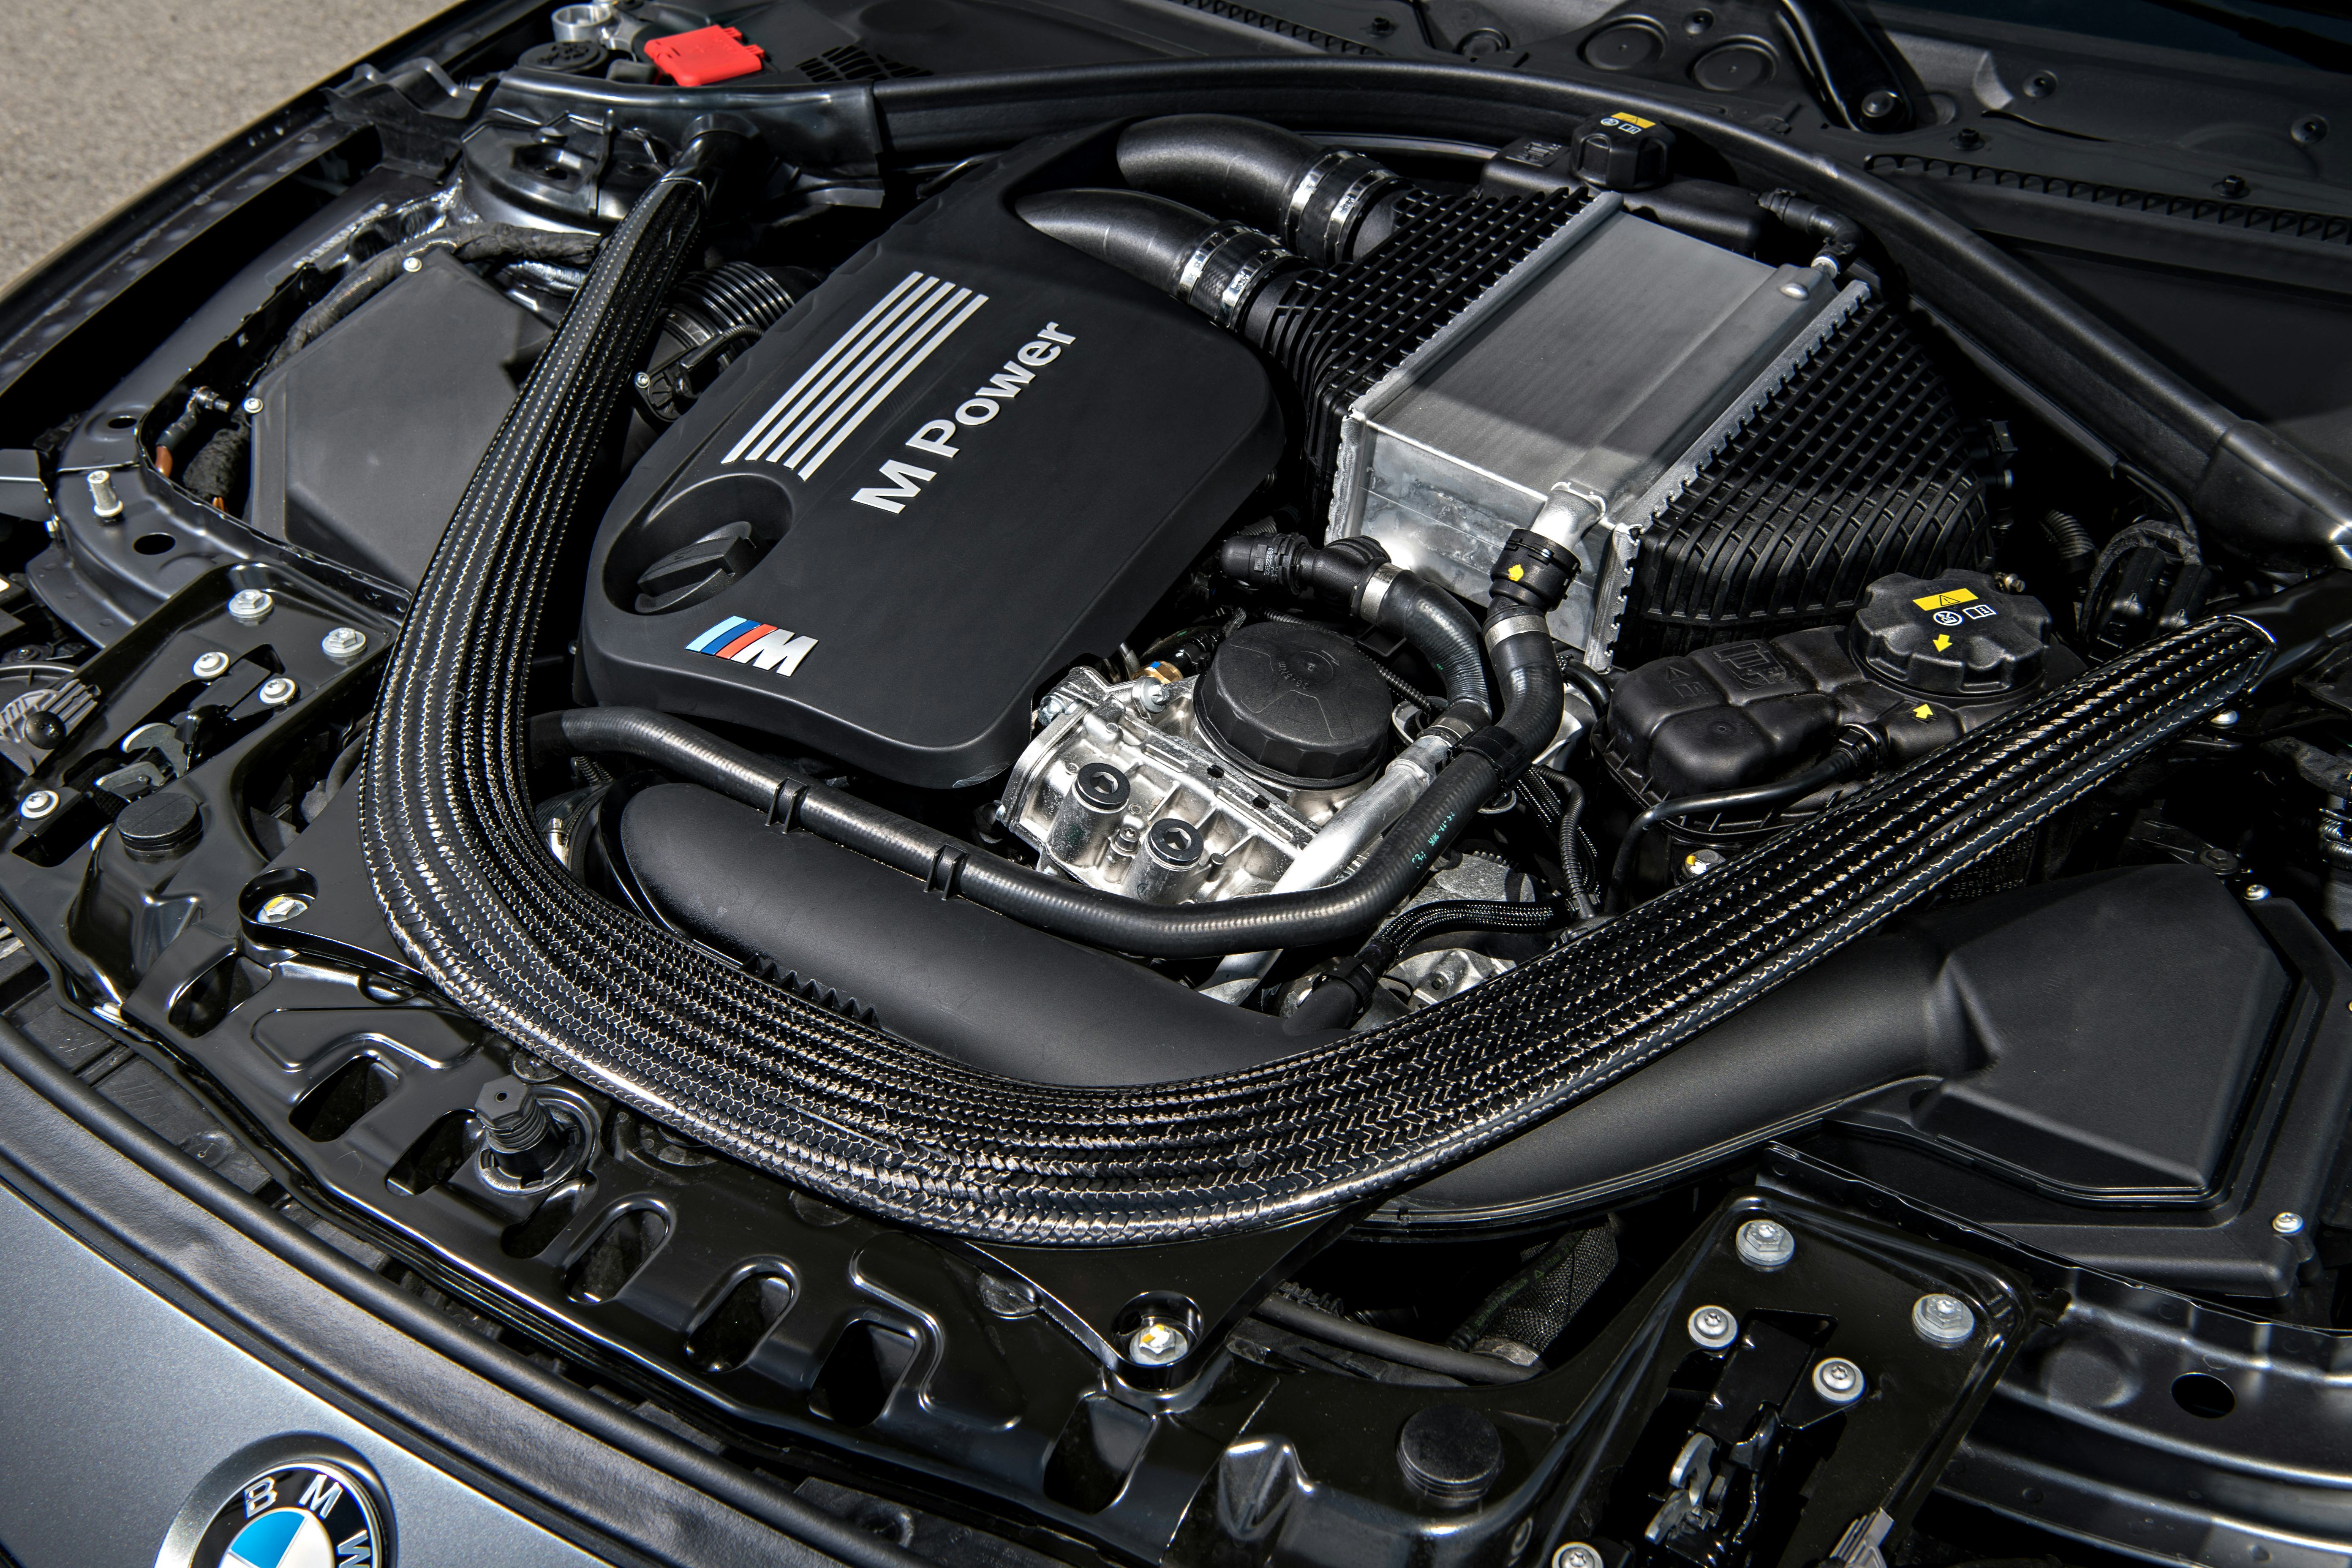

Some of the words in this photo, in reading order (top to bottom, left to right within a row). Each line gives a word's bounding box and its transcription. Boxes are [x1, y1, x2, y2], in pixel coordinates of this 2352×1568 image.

[851, 459, 937, 514] M
[905, 321, 1076, 458] Power
[730, 628, 819, 678] M
[244, 1474, 371, 1568] BMW
